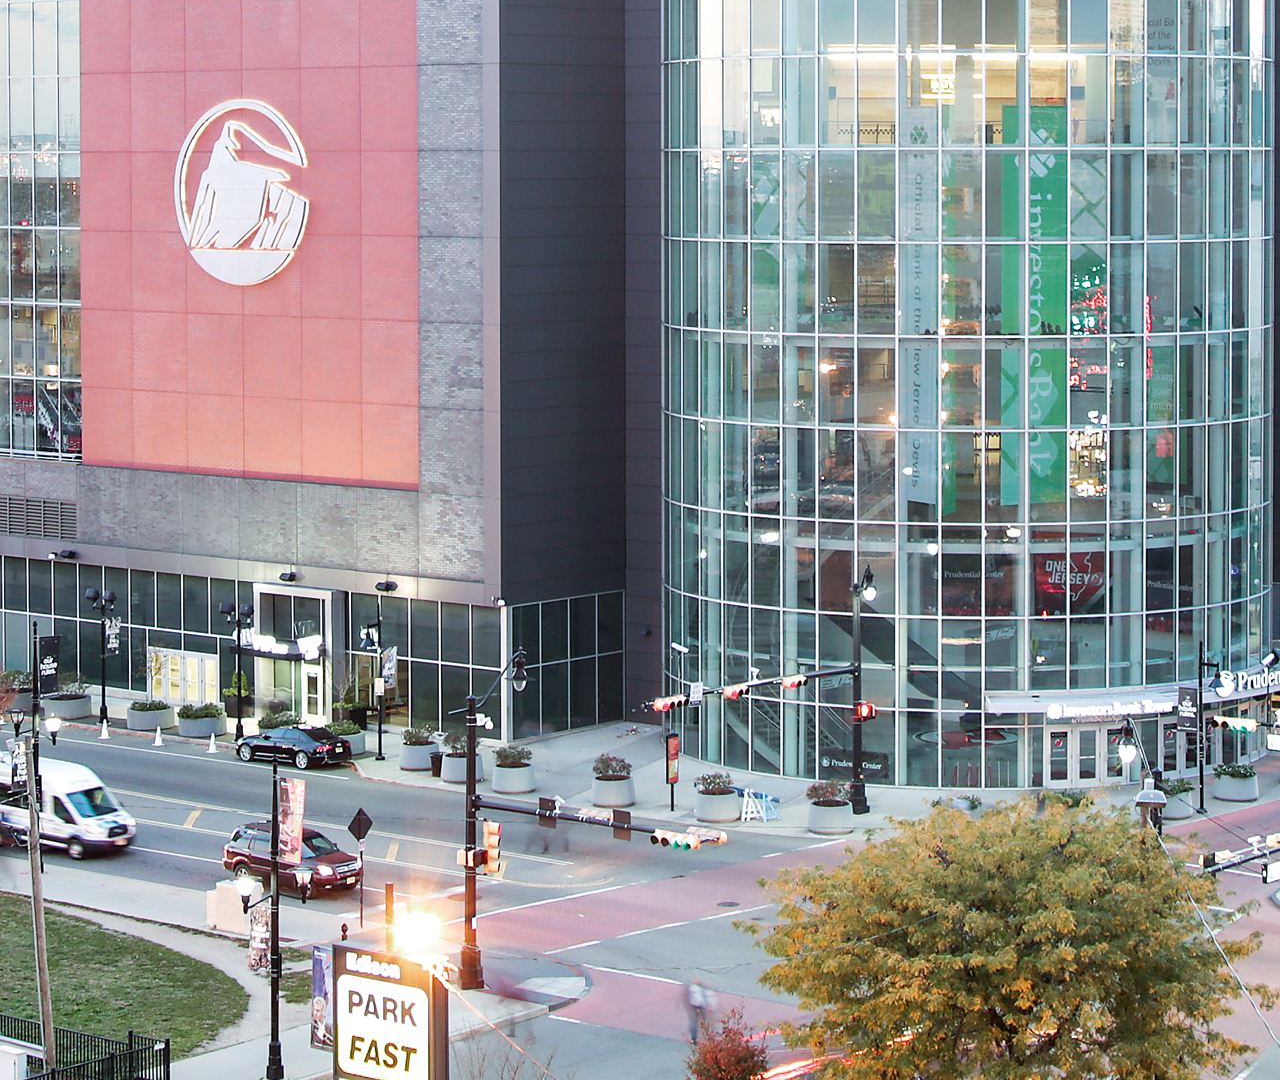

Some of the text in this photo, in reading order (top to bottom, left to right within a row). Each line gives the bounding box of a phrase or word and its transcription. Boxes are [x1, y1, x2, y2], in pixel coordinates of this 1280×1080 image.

[914, 173, 924, 232] Official
[912, 381, 922, 425] Jerse
[1045, 560, 1067, 573] ONE
[345, 951, 401, 980] Edison
[348, 989, 417, 1028] PARK
[349, 1035, 418, 1072] FAST
